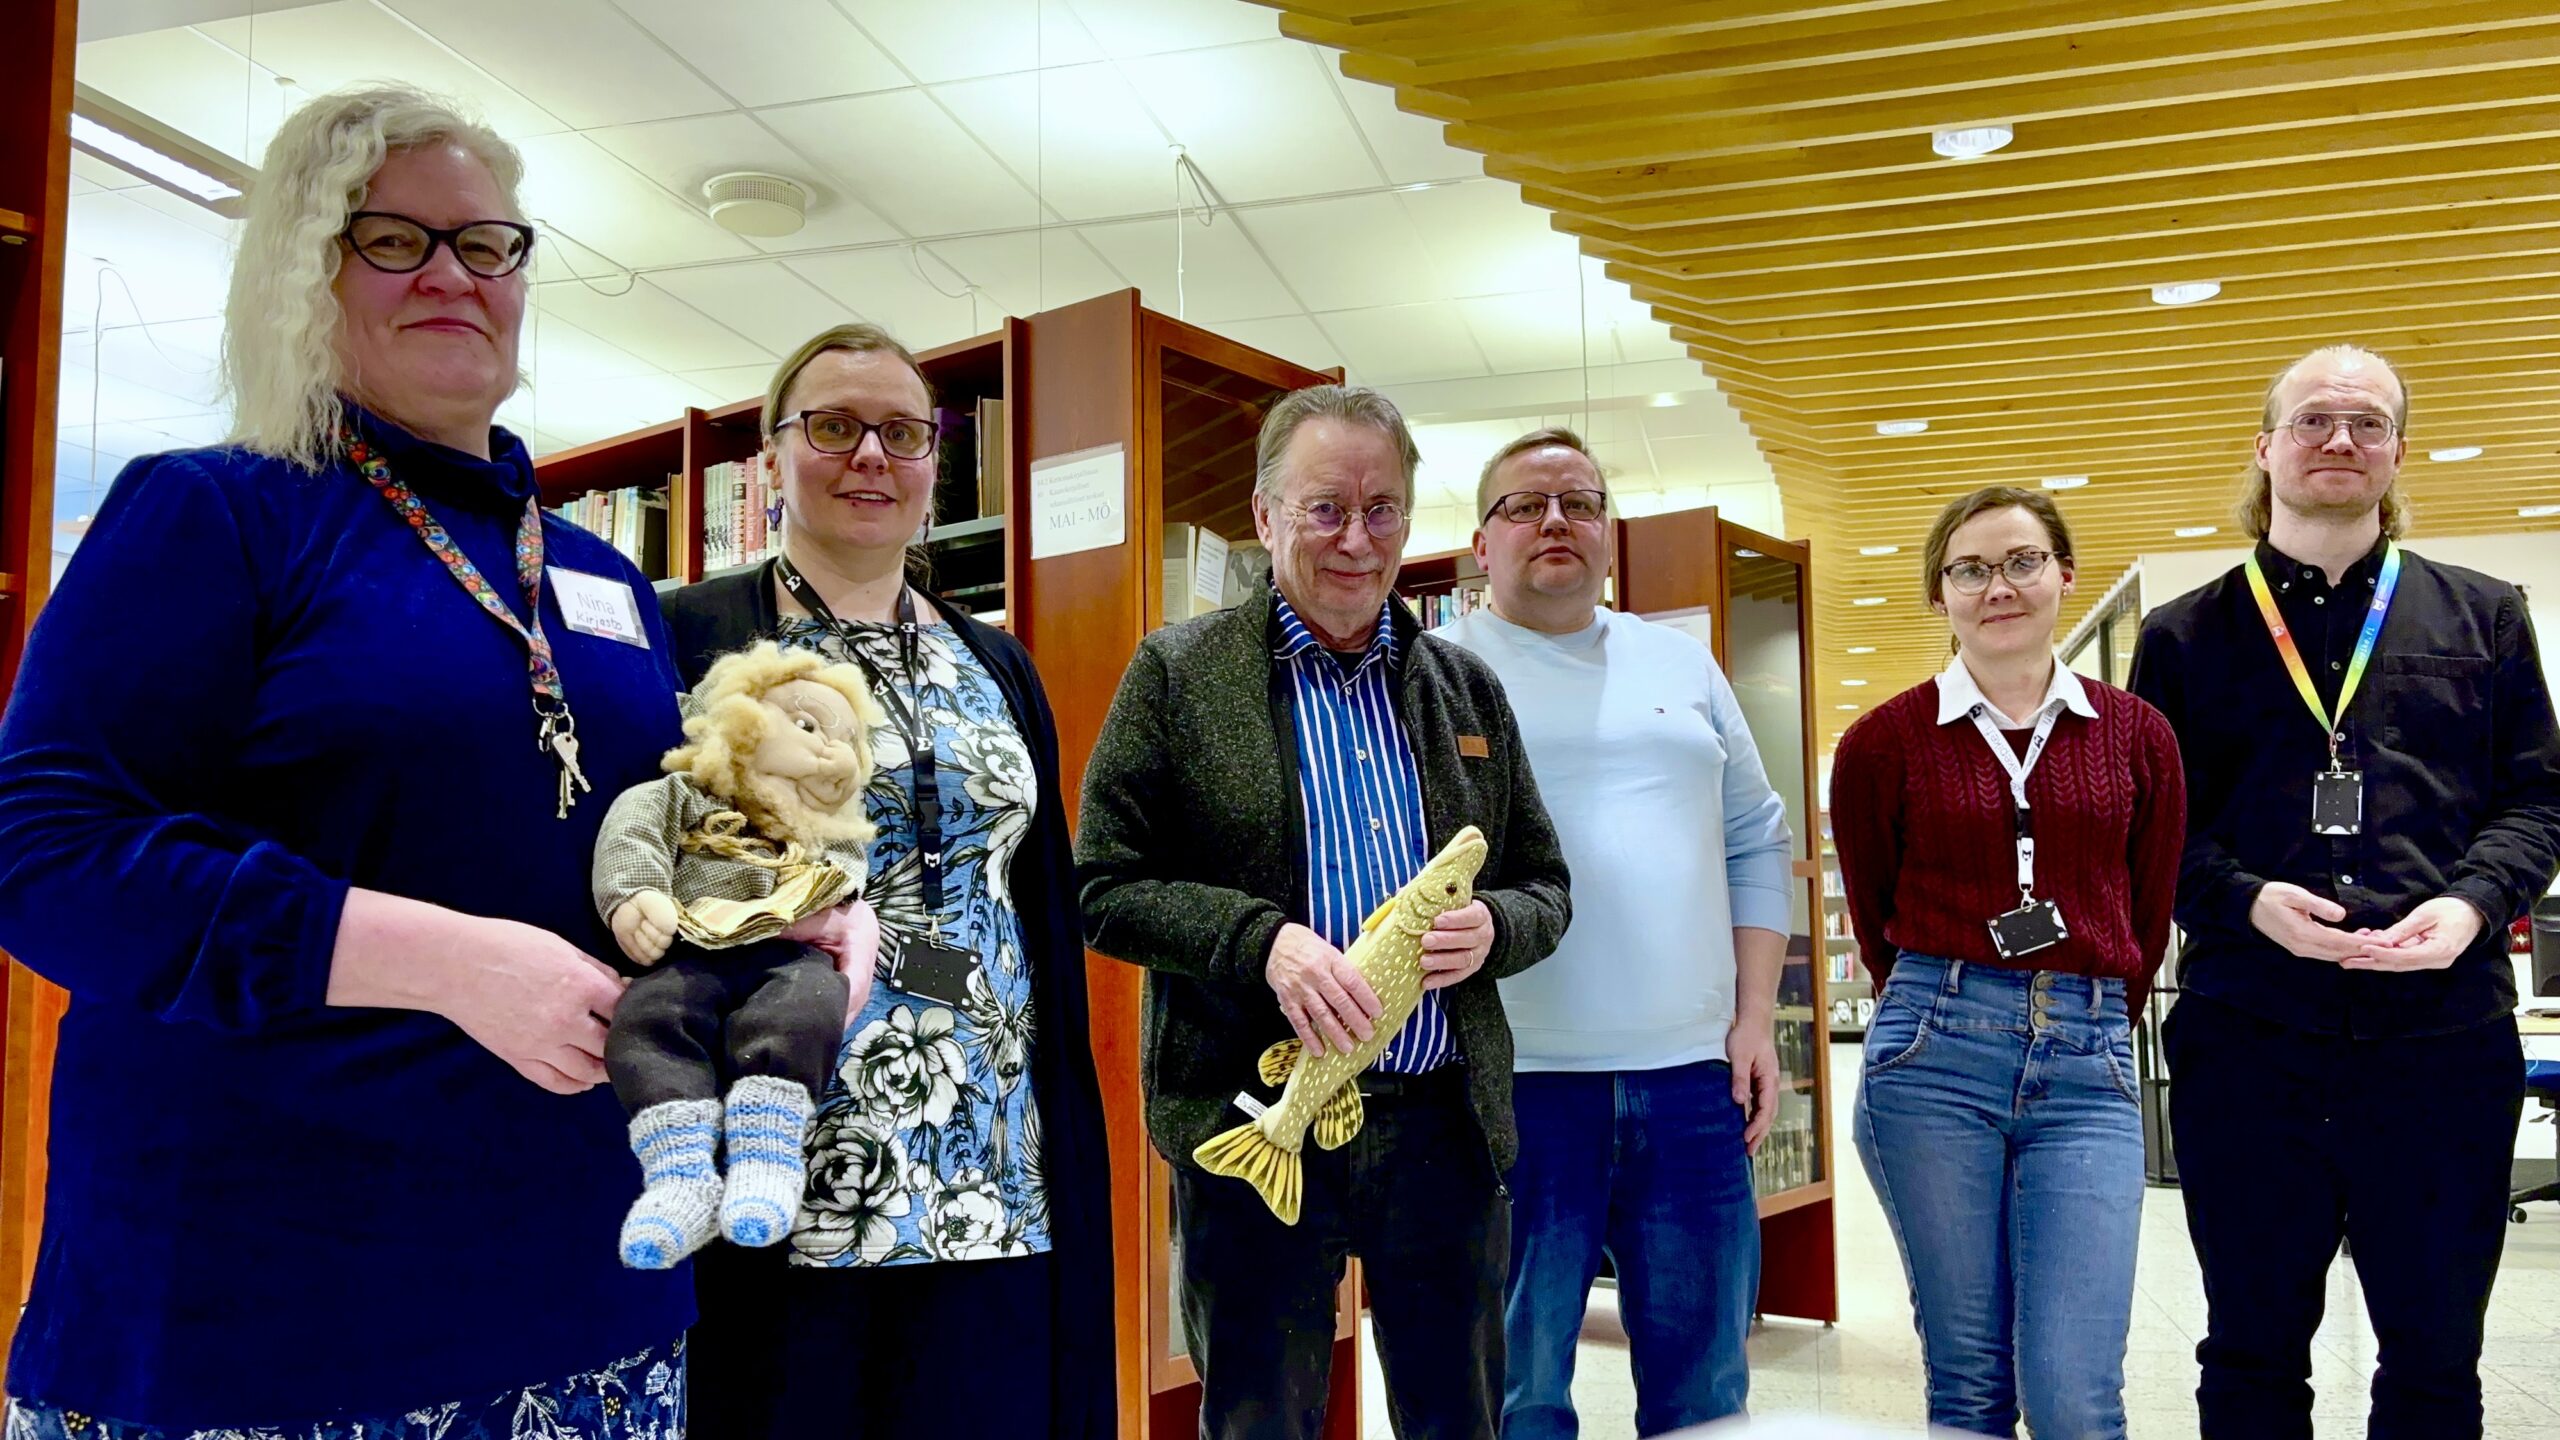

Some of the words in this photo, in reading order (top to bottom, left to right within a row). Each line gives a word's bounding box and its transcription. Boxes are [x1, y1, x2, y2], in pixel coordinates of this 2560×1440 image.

[1049, 511, 1075, 530] MAI
[1087, 501, 1111, 522] MÖ
[576, 591, 616, 615] Nina
